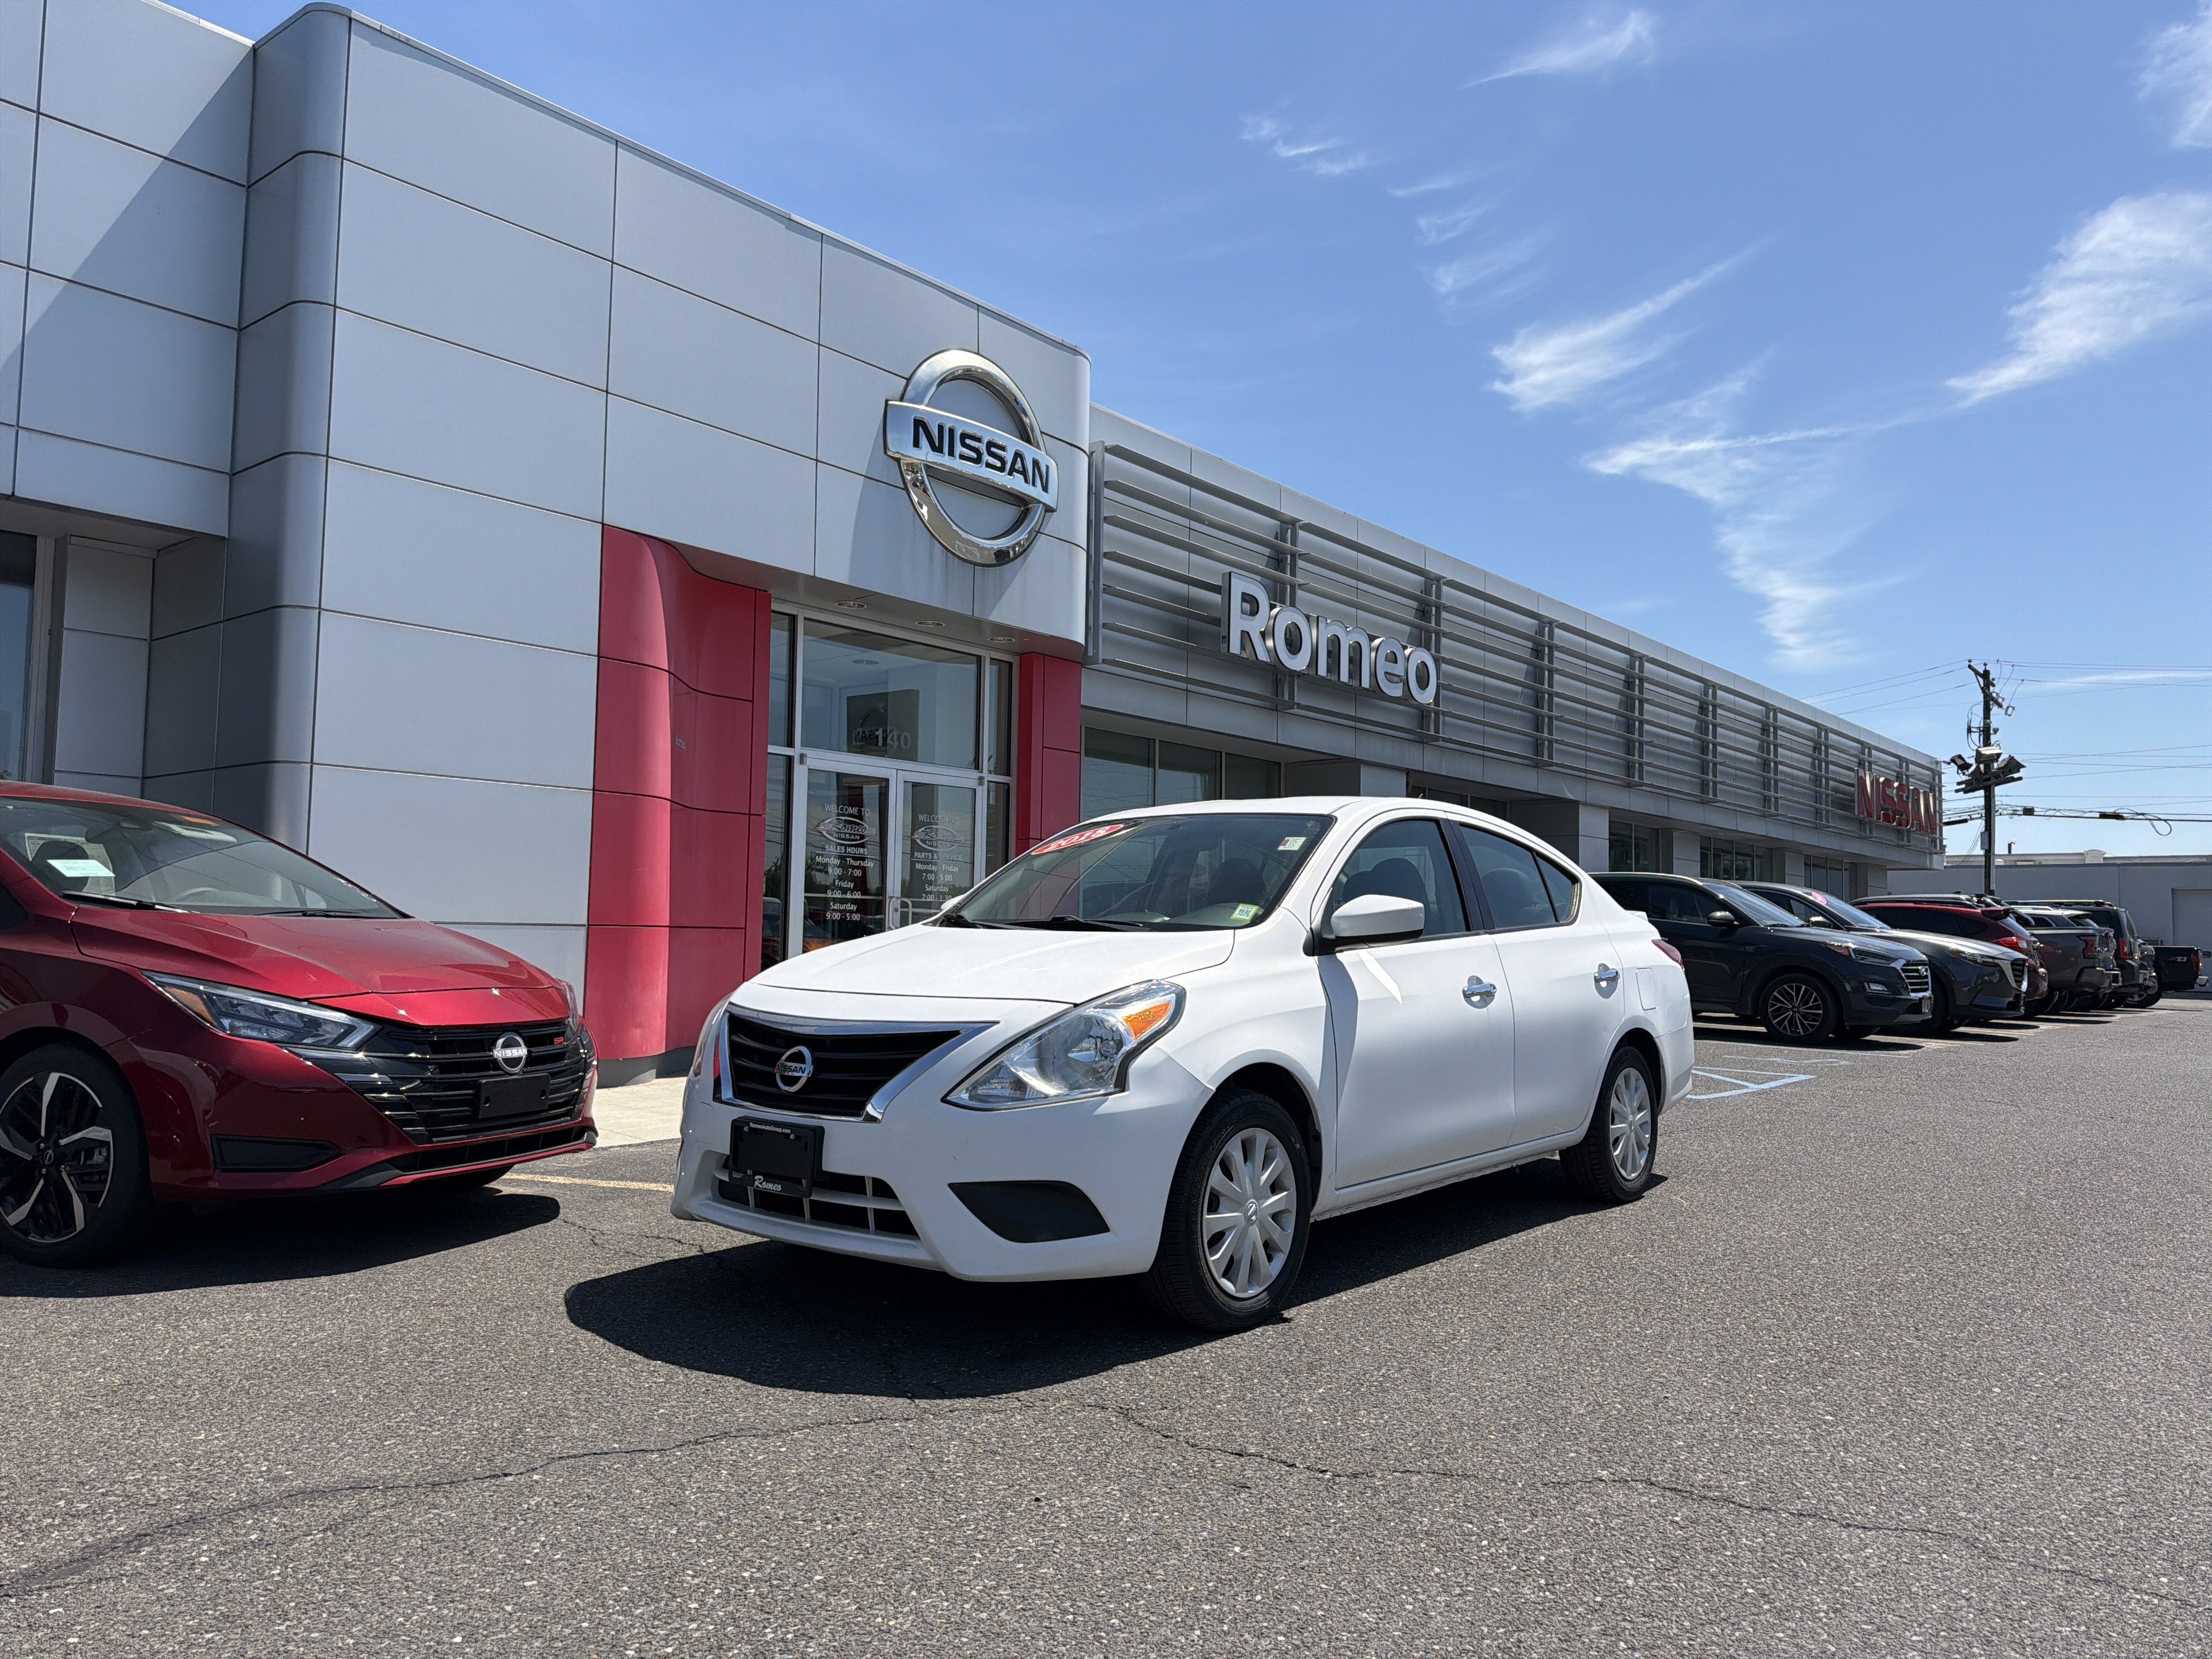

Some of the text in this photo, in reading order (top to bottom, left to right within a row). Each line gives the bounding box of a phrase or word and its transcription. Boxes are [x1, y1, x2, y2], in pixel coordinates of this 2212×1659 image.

[912, 415, 1050, 494] NISSAN
[1222, 571, 1437, 704] Romeo
[875, 727, 911, 749] 140
[1854, 768, 1937, 835] NISSAN
[825, 804, 870, 816] WELCOME TO
[831, 818, 866, 833] Romeo
[847, 847, 868, 855] HOURS
[815, 856, 840, 866] Monday
[846, 858, 874, 868] Thursday
[828, 867, 842, 875] 9:00
[848, 868, 862, 877] 7:00
[916, 863, 938, 872] Monday
[943, 865, 959, 873] Friday
[835, 879, 854, 889] Friday
[925, 884, 949, 893] Saturday
[830, 901, 857, 911] Saturday
[554, 1036, 564, 1045] SR
[494, 1049, 527, 1058] NISSAN
[777, 1063, 806, 1074] NISSAN
[754, 1175, 781, 1191] Romeo
